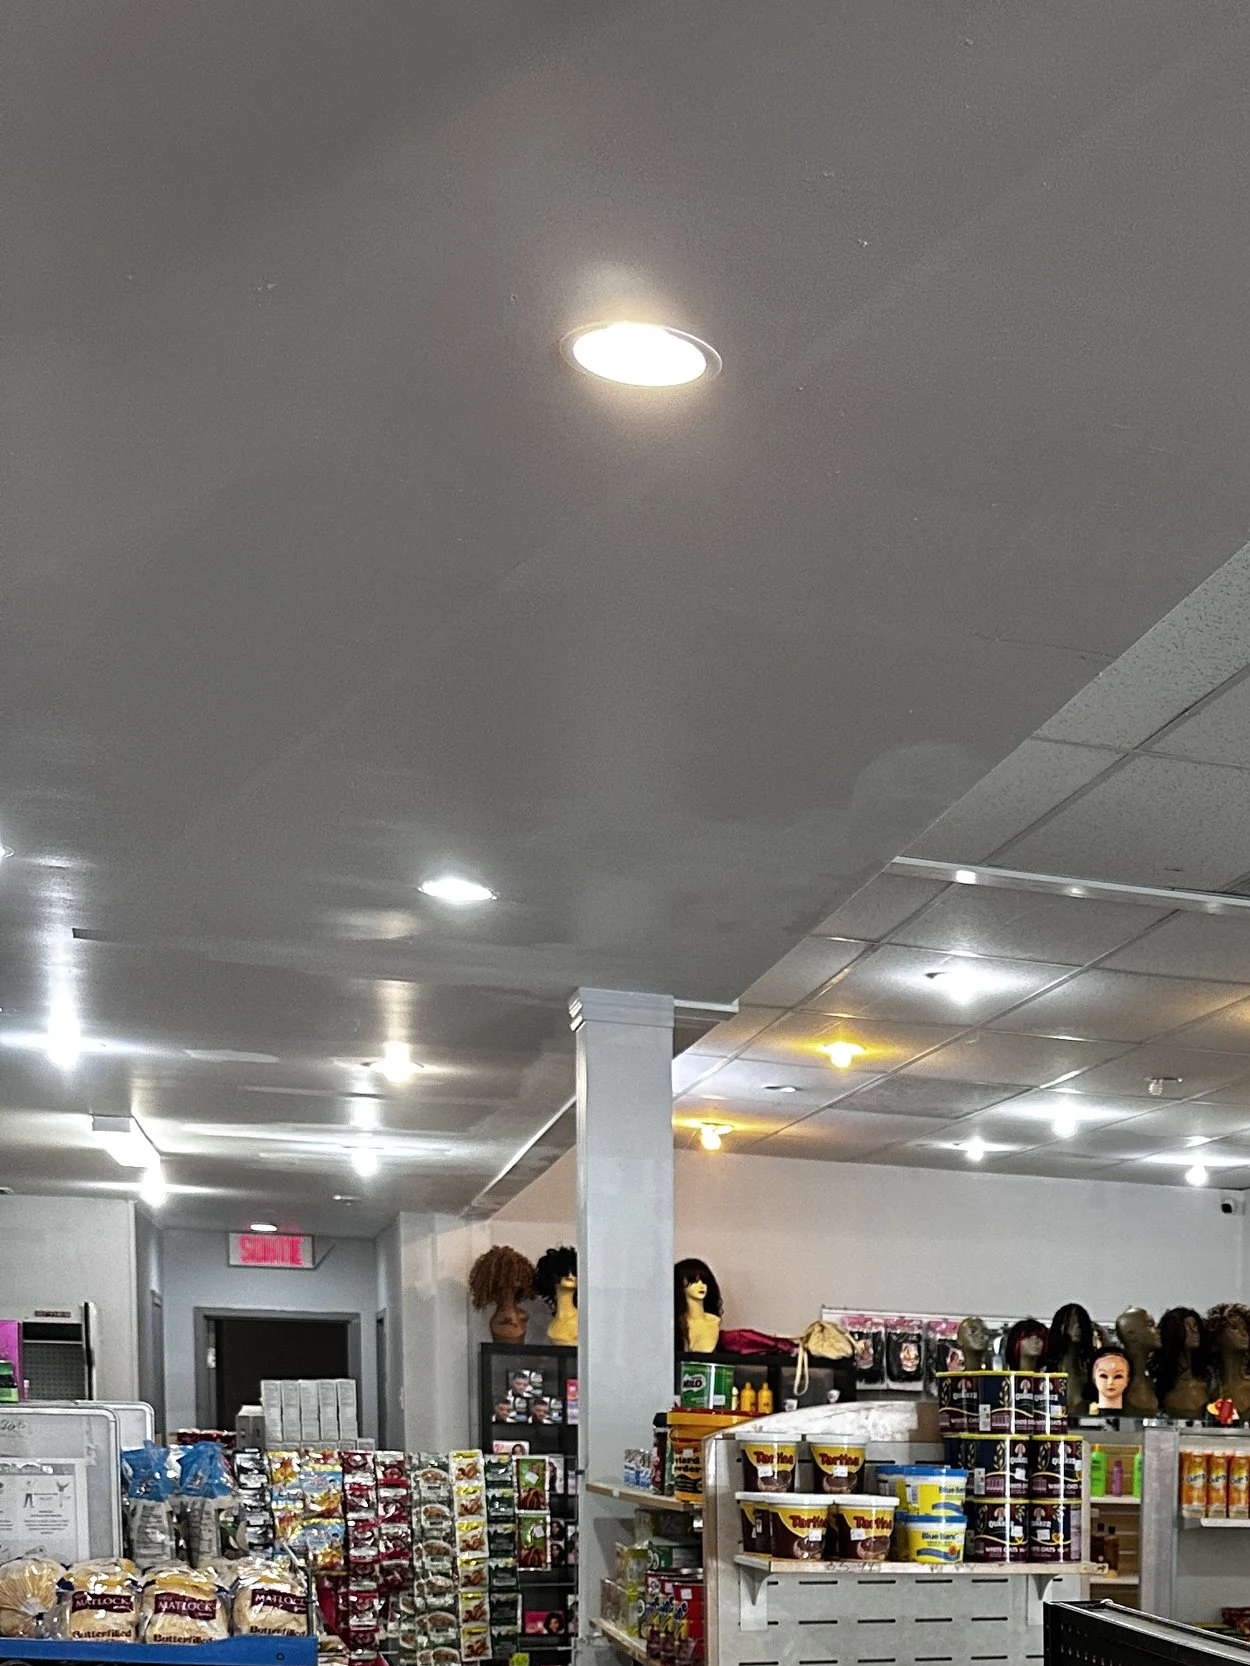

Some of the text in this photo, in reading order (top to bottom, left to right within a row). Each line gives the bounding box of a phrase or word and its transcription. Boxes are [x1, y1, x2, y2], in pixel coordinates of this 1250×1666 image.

[240, 1236, 304, 1266] SORTIE
[75, 1596, 131, 1608] MATLOCK
[158, 1600, 214, 1612] MATLOCK
